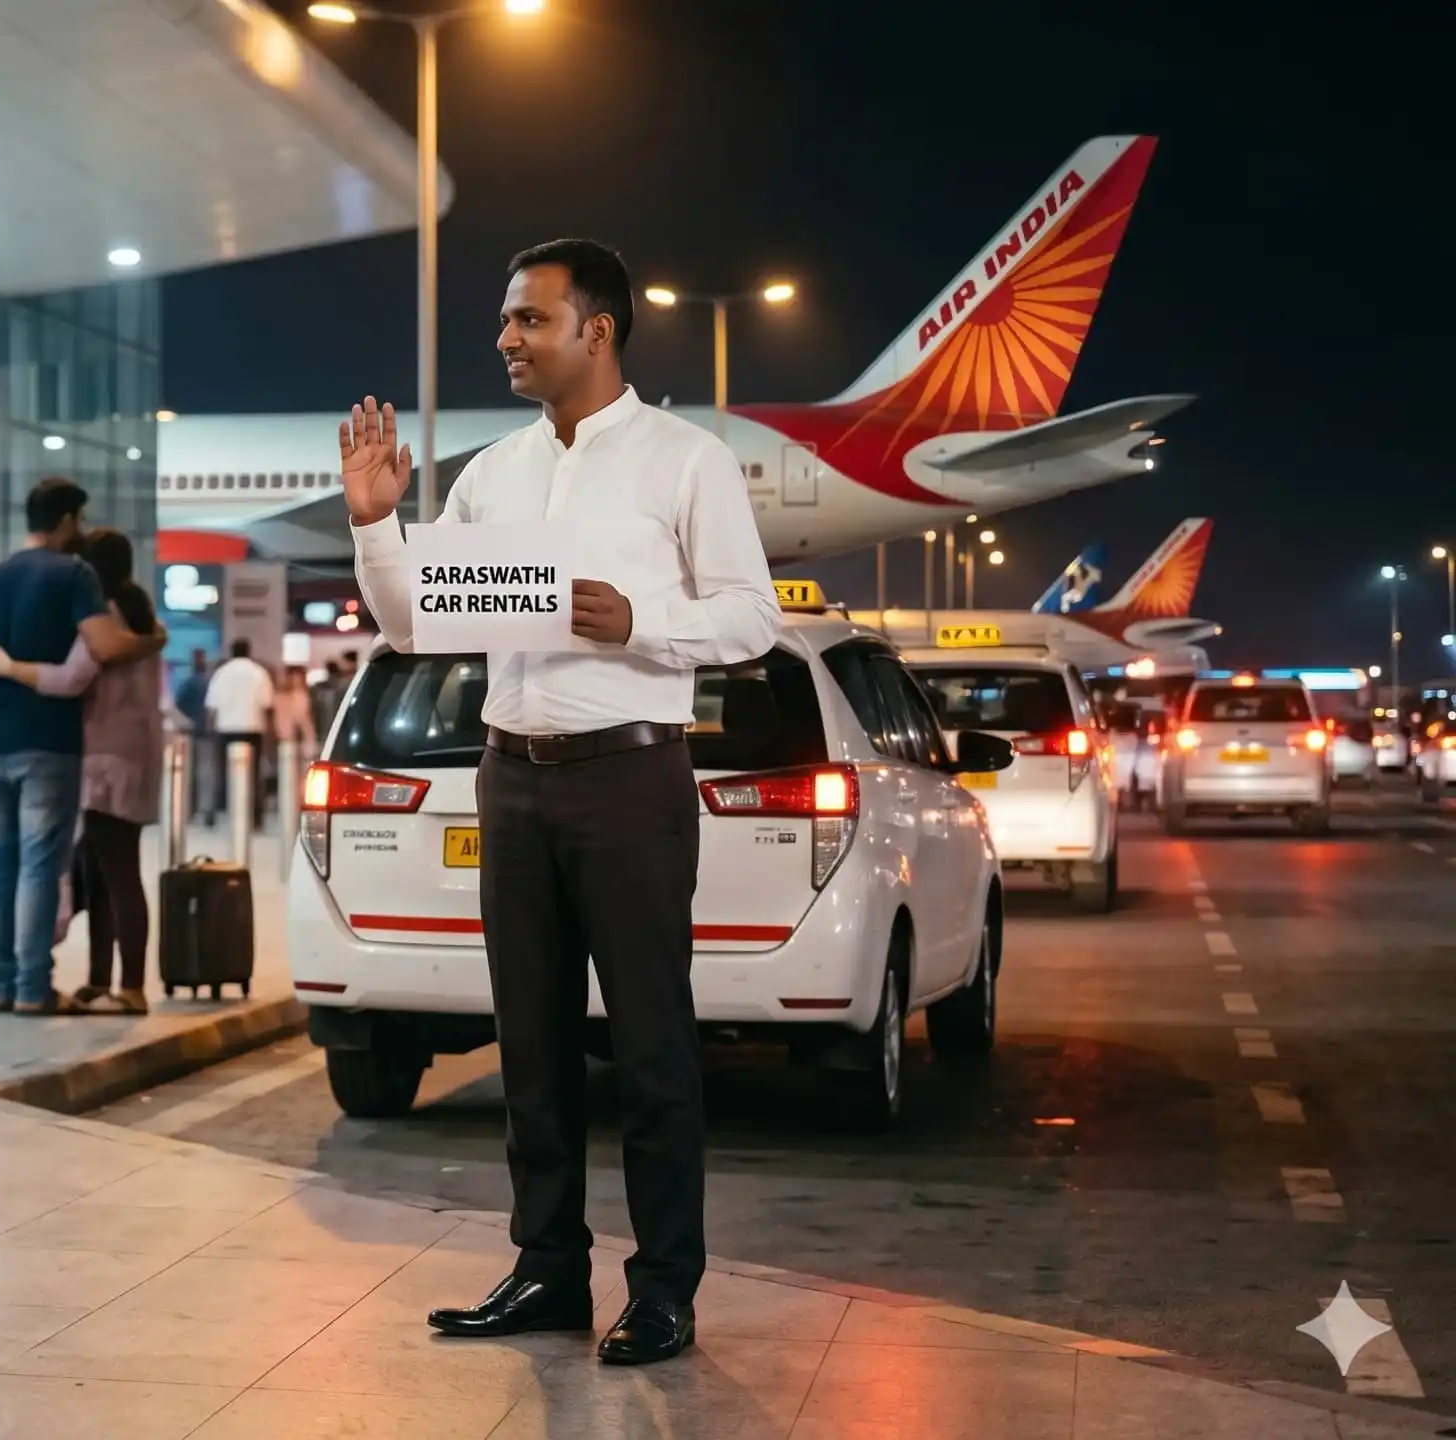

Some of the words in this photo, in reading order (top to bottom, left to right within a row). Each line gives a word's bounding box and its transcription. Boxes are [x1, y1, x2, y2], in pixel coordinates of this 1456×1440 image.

[918, 279, 977, 351] AIR
[983, 169, 1085, 280] INDIA
[421, 566, 556, 584] SARASWATHI
[774, 586, 808, 602] XI
[420, 594, 462, 613] CAR
[467, 594, 558, 613] RENTALS
